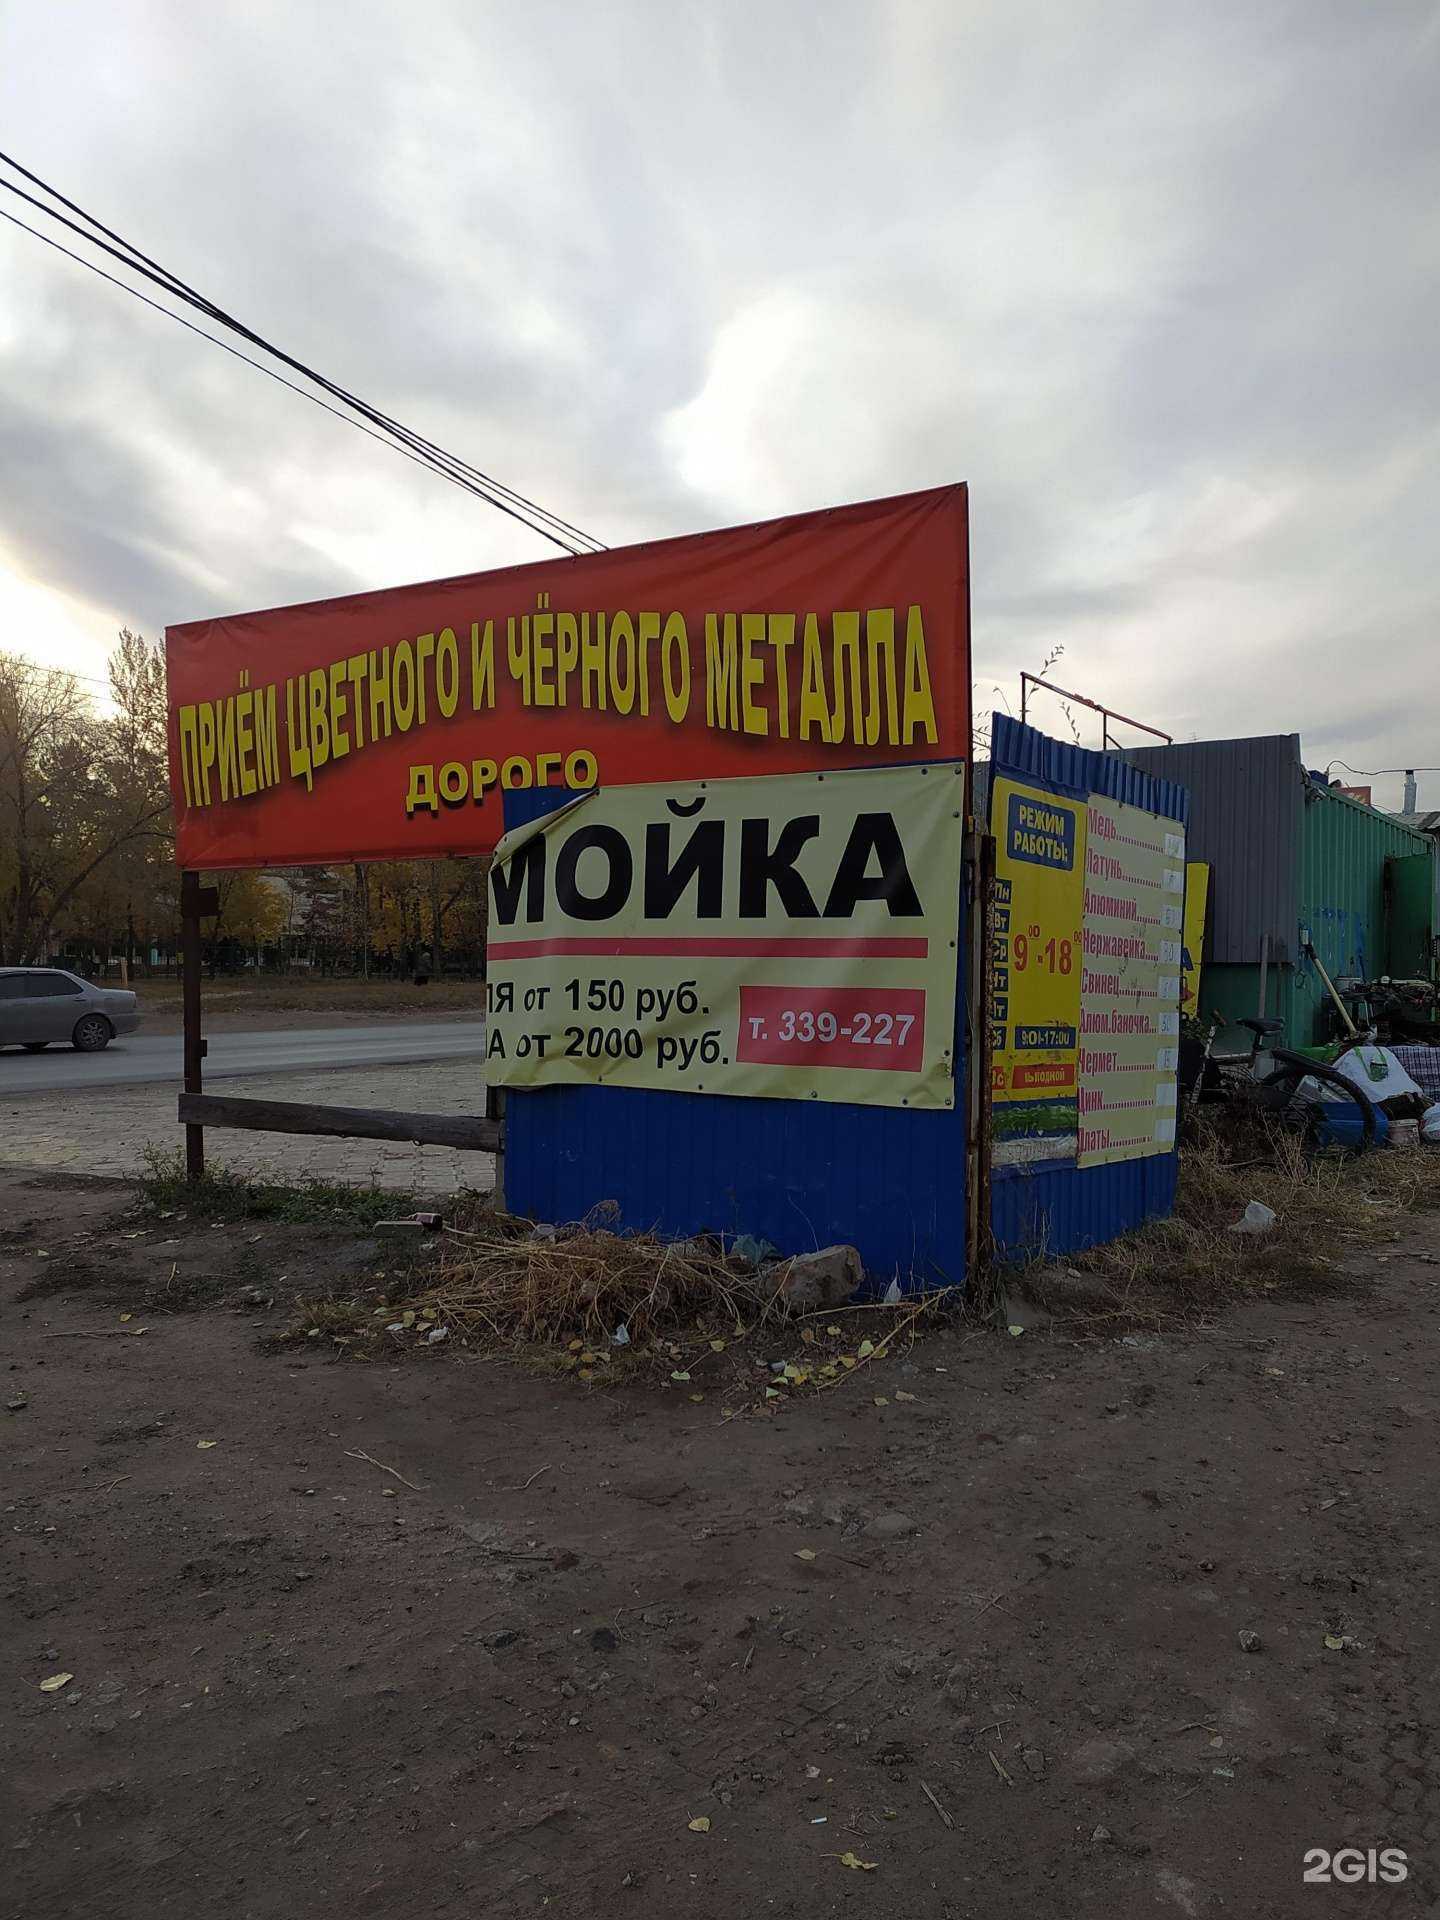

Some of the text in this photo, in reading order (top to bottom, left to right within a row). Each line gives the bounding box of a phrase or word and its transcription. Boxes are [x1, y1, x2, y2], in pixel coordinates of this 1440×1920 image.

[179, 592, 939, 808] ПРИЁМ ЦВЕТНОГО И ЧЁРНОГО МЕТАЛЛА
[405, 749, 599, 813] ДОРОГО
[1019, 804, 1065, 836] РЕЖИМ
[1082, 927, 1145, 960] Нержавейка
[523, 985, 551, 1012] от
[565, 978, 625, 1013] 150
[636, 980, 710, 1022] руб.
[1081, 967, 1120, 998] Свинец
[516, 1034, 551, 1059] от
[564, 1026, 644, 1059] 2000
[657, 1030, 729, 1071] руб.
[749, 1011, 915, 1047] т. 339-227
